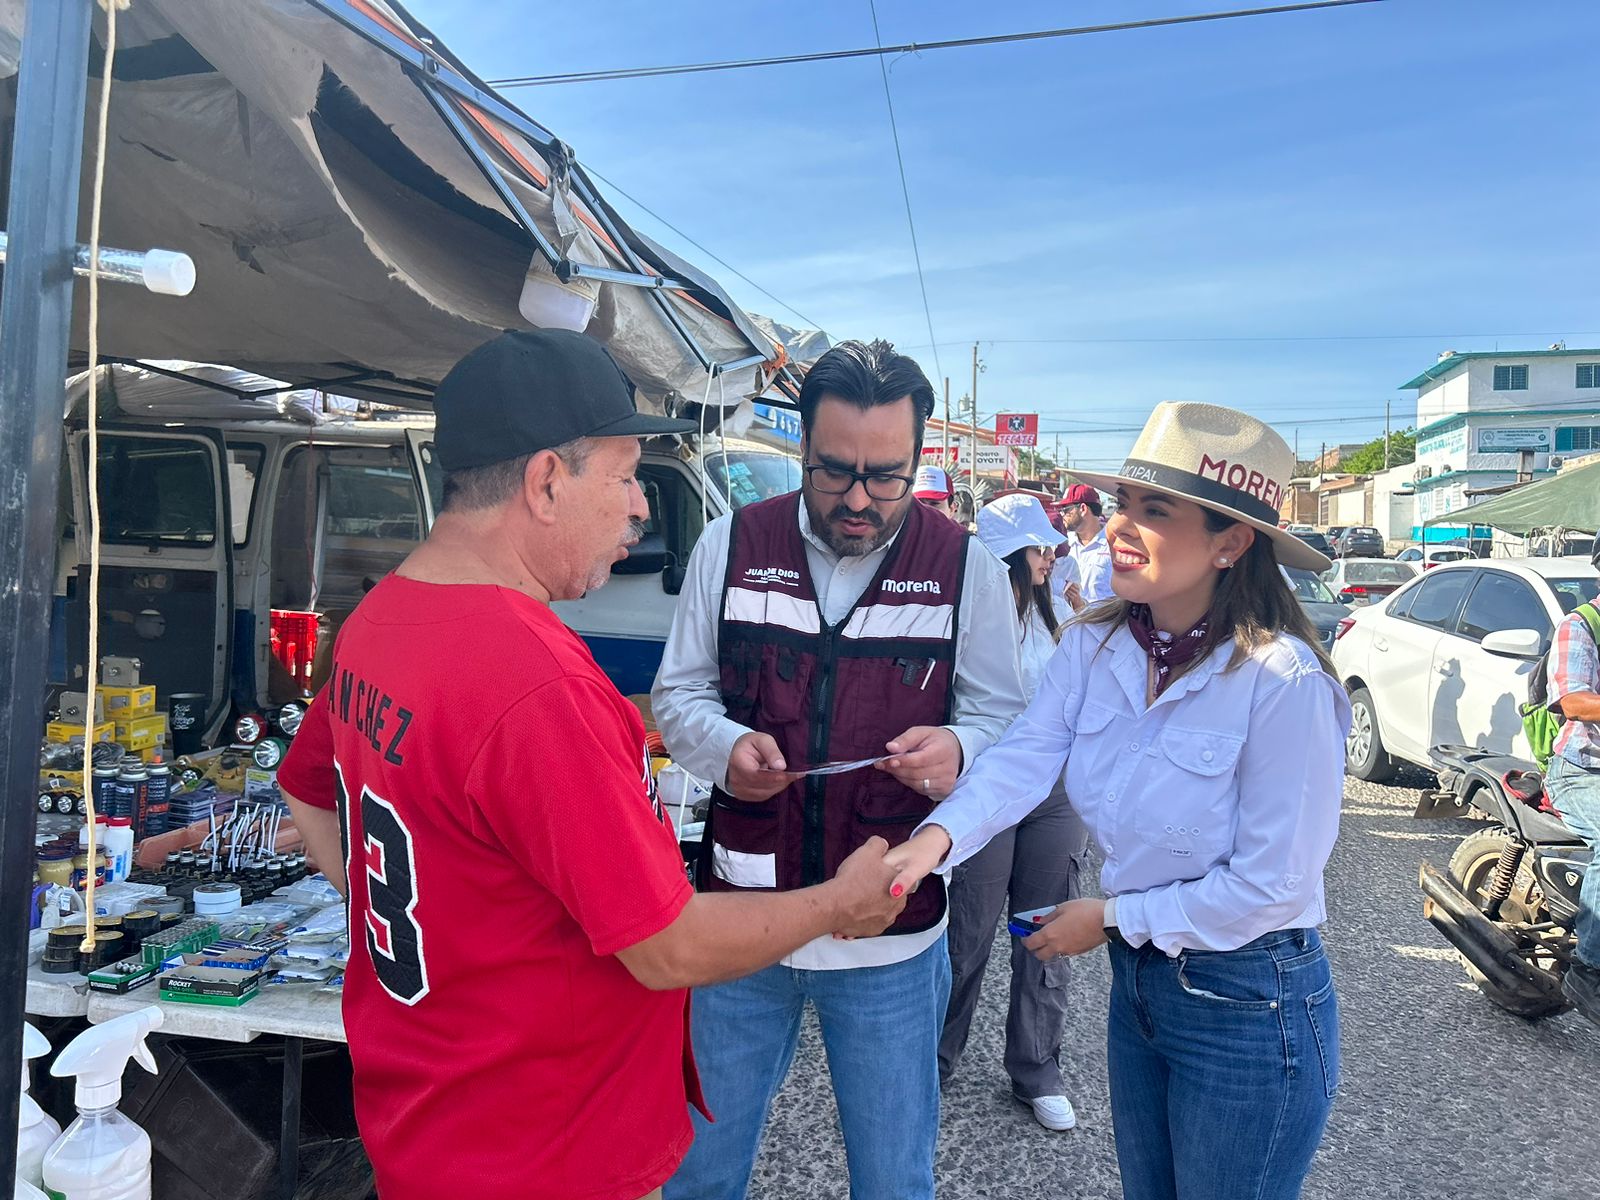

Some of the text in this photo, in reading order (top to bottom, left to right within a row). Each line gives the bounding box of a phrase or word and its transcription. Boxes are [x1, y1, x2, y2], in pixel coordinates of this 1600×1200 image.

[997, 433, 1035, 446] TECATE
[1198, 453, 1286, 511] MOREN
[777, 568, 800, 580] DIOS
[881, 578, 942, 594] morena
[168, 979, 192, 988] ROCKET
